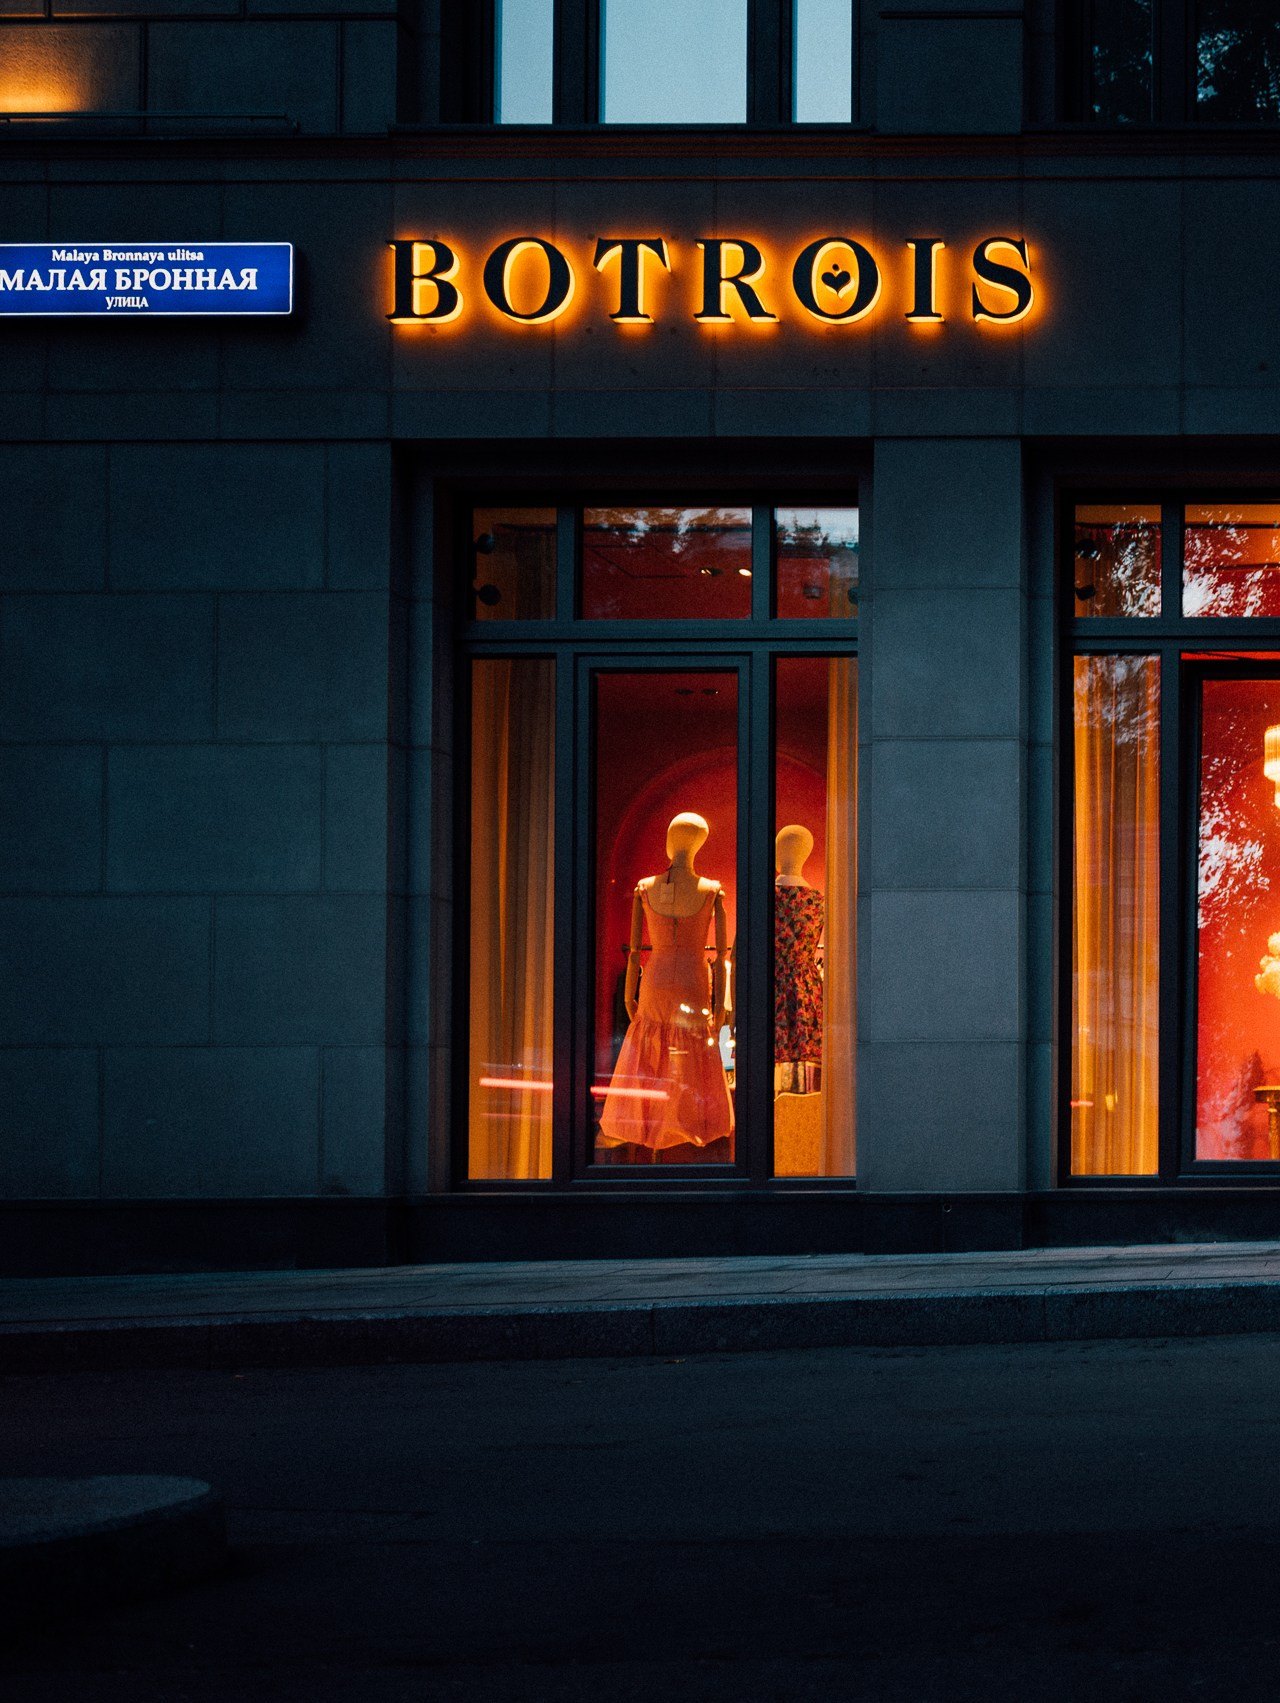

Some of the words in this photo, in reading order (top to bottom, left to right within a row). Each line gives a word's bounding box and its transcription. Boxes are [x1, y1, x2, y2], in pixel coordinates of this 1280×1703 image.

[52, 249, 99, 264] Malaya
[103, 249, 164, 264] Bronnaya
[168, 249, 204, 261] ulitsa
[0, 269, 107, 291] МАЛАЯ
[114, 268, 258, 291] БРОННАЯ
[385, 237, 1035, 324] BOTROIS
